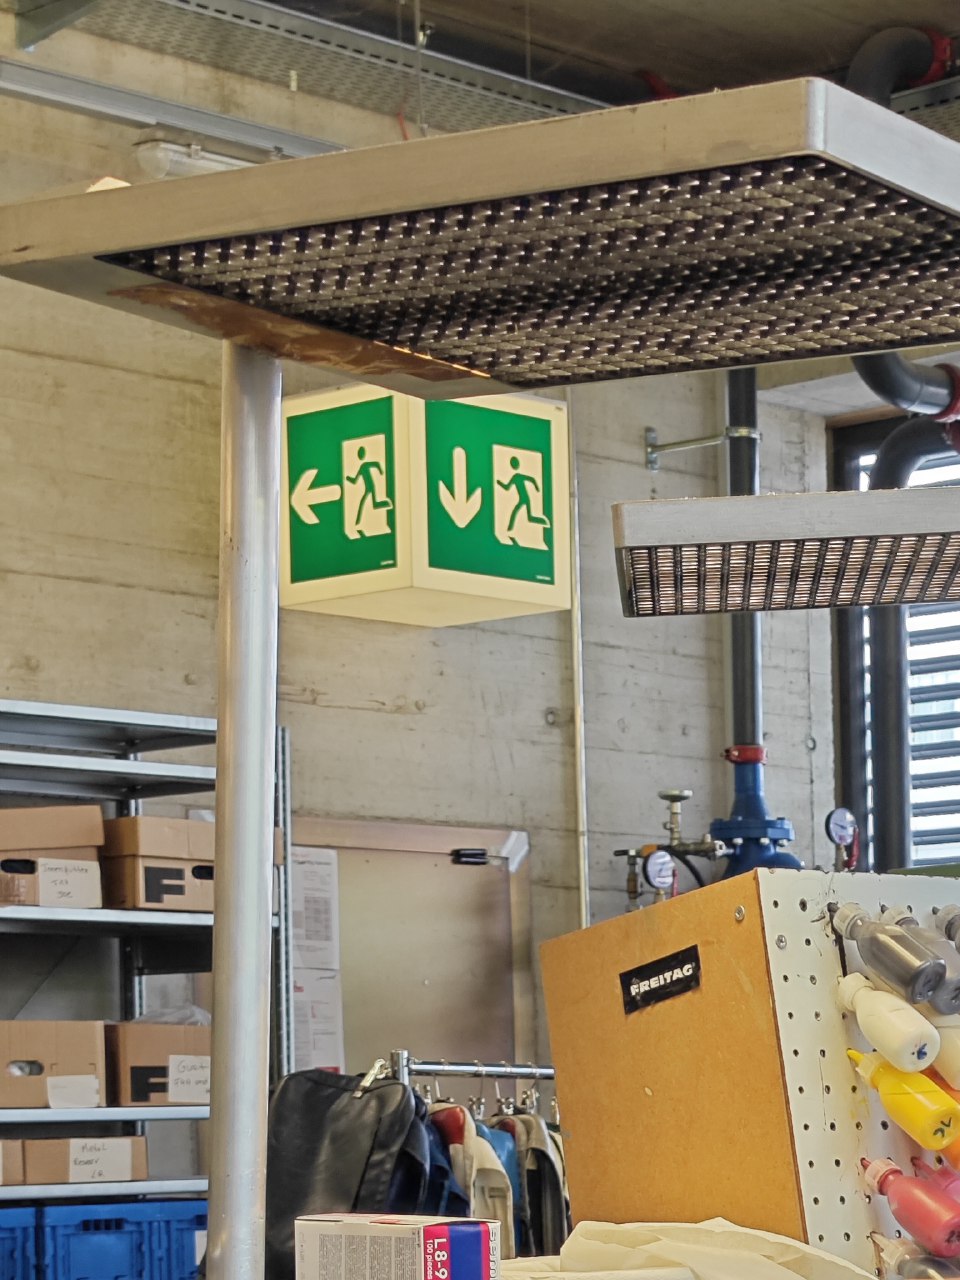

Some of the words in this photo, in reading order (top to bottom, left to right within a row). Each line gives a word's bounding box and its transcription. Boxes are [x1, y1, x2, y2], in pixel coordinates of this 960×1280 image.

[144, 866, 185, 903] F
[630, 963, 694, 996] FREITAG
[426, 1239, 434, 1254] 100
[425, 1254, 434, 1280] pieces
